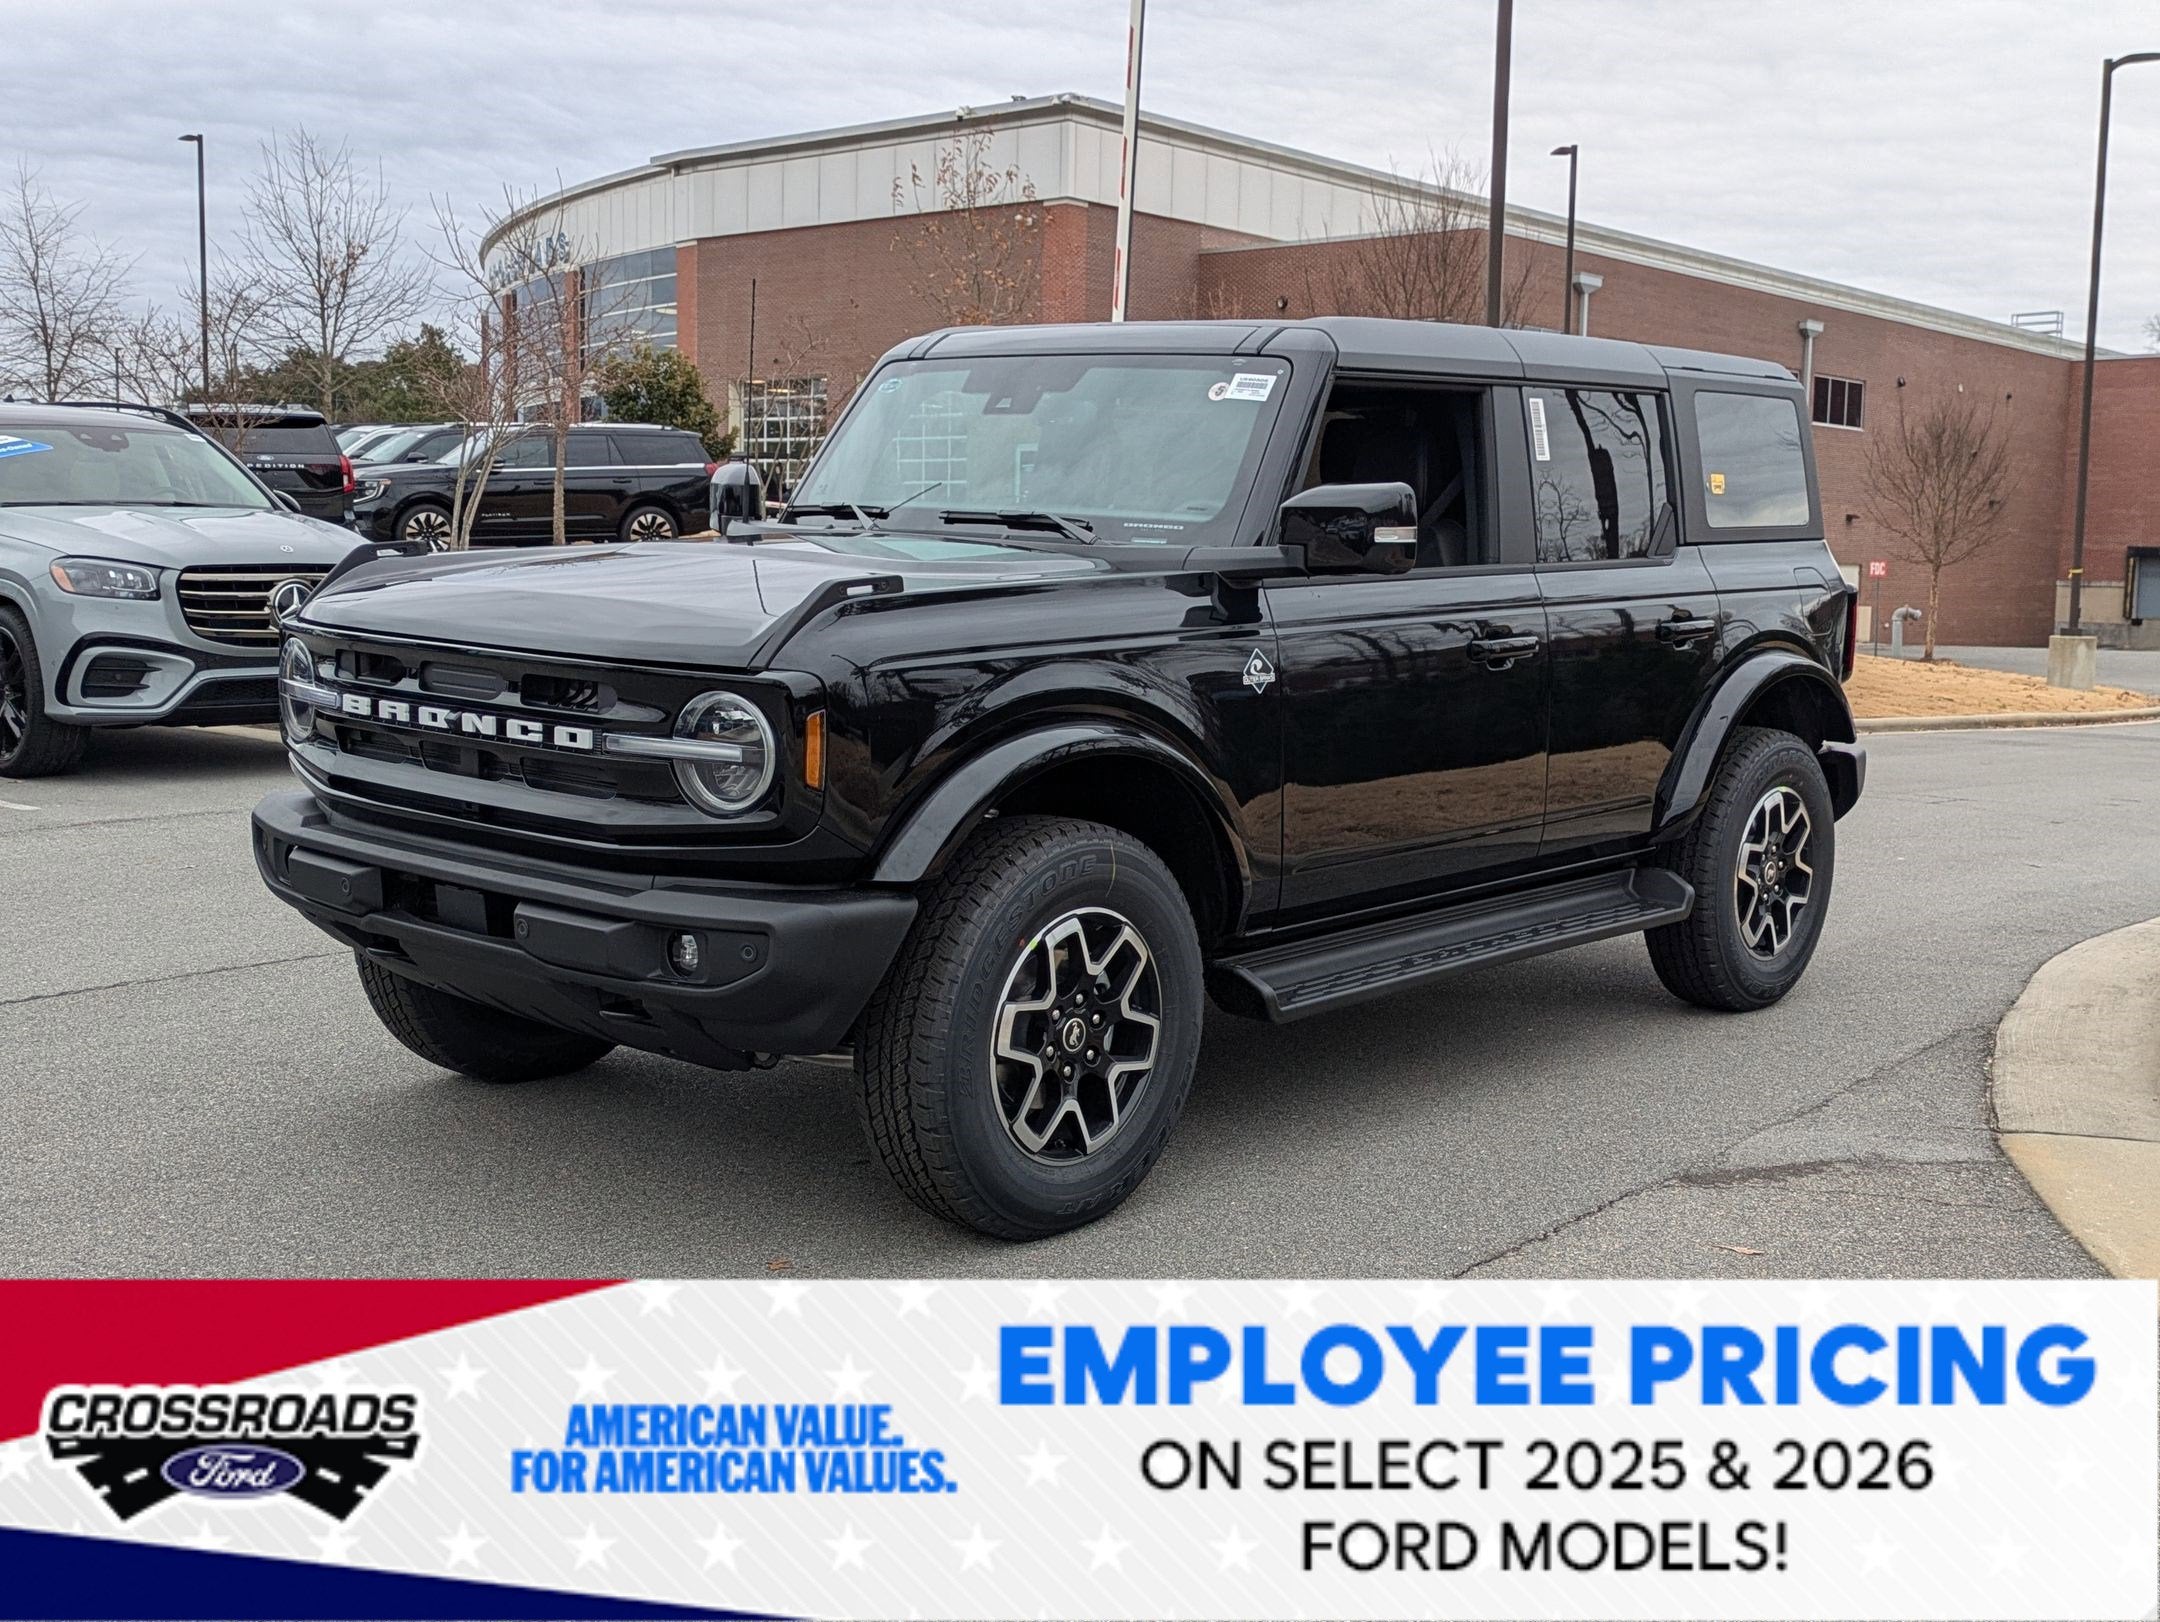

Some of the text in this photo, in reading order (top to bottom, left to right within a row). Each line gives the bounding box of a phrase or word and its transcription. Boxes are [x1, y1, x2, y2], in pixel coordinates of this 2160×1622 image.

[1870, 561, 1886, 576] FDC
[342, 693, 594, 750] BRONCO
[957, 854, 1098, 1099] BRIDGESTONE
